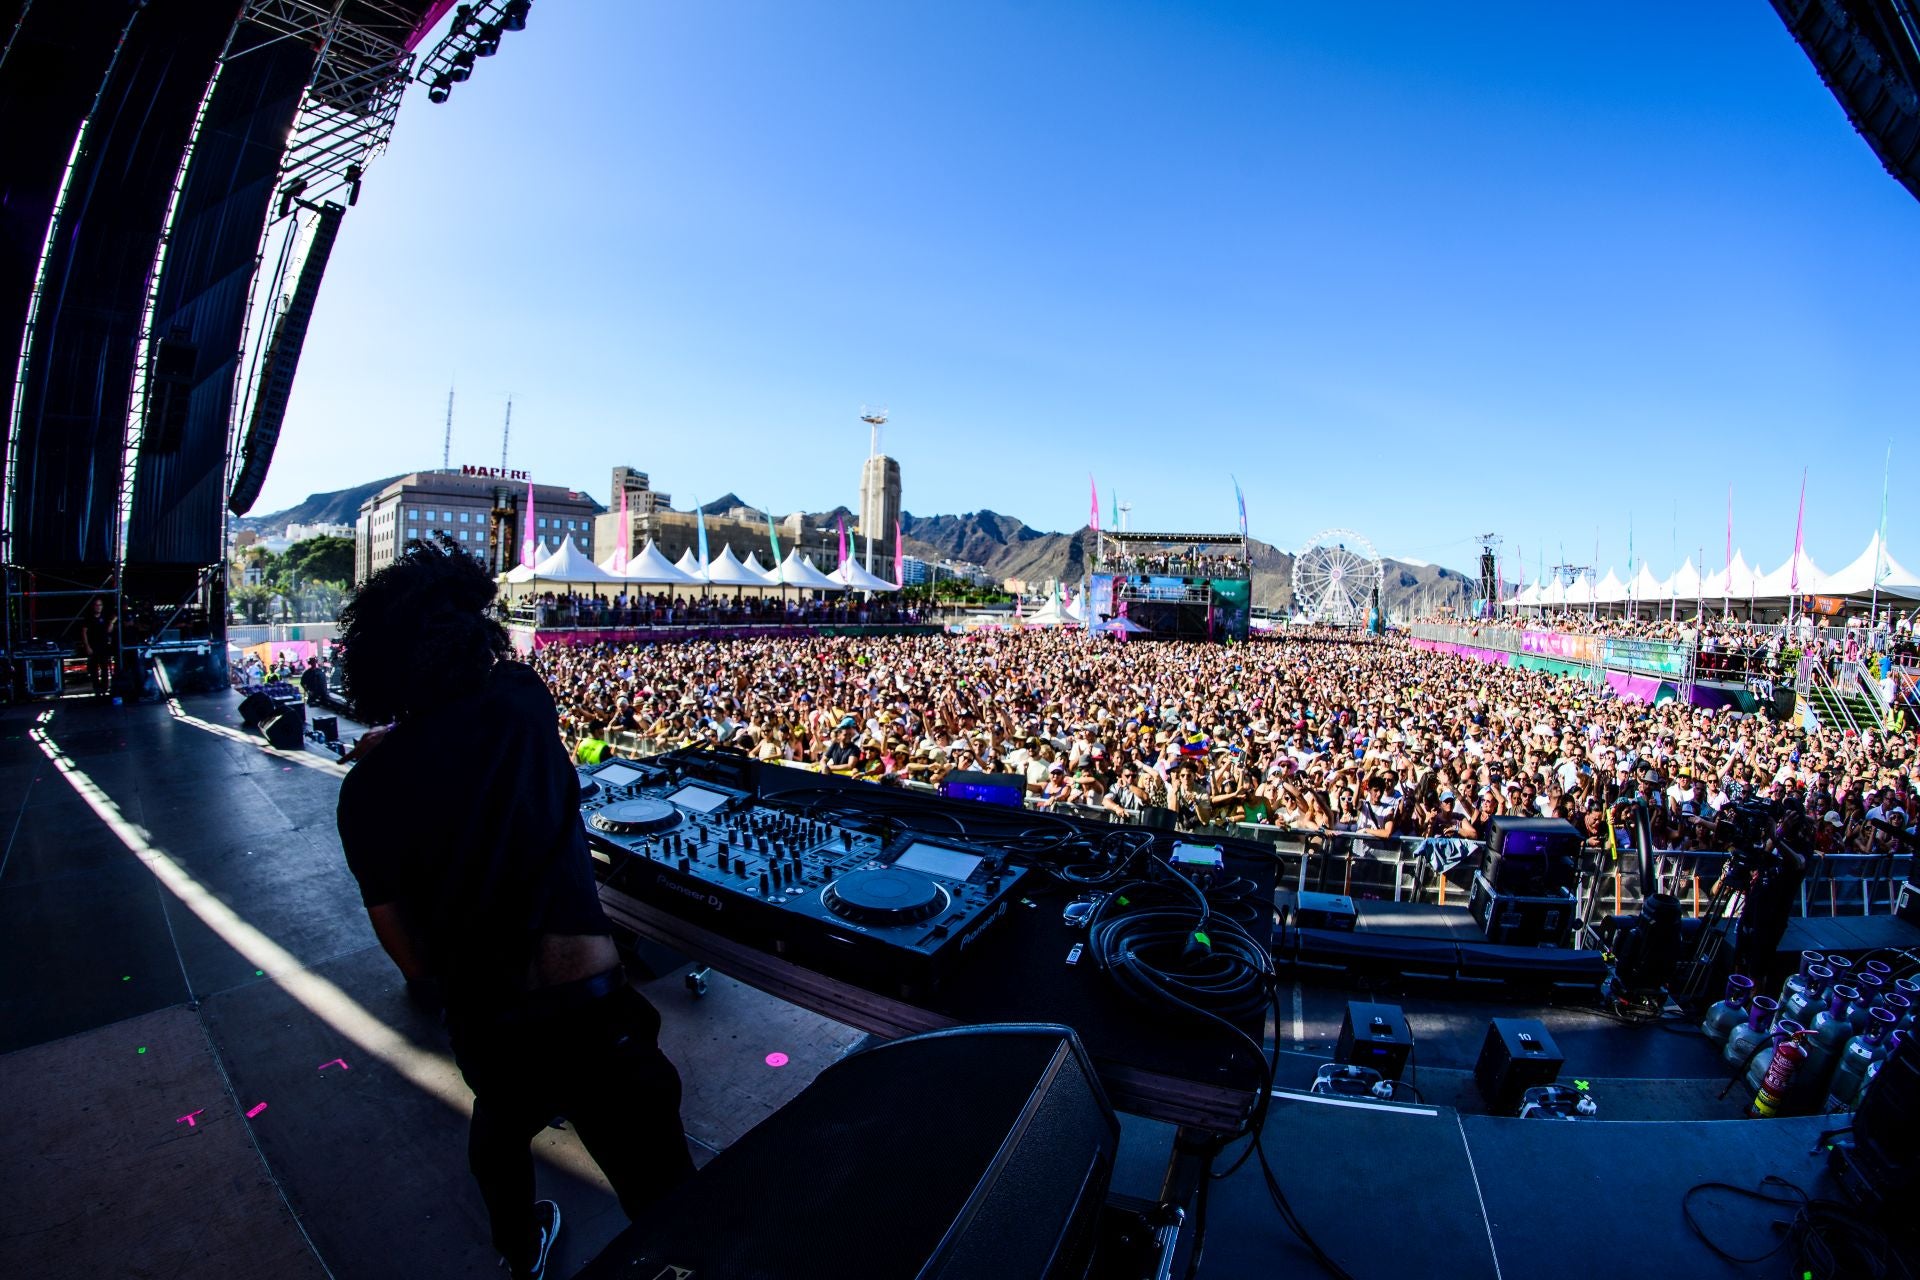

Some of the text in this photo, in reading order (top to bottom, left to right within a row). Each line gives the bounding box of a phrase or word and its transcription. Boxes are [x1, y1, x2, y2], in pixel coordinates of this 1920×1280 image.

[462, 464, 532, 480] MAPFRE
[656, 872, 705, 901] Pioneer
[960, 912, 998, 952] Pioneer
[1518, 1032, 1532, 1041] 10
